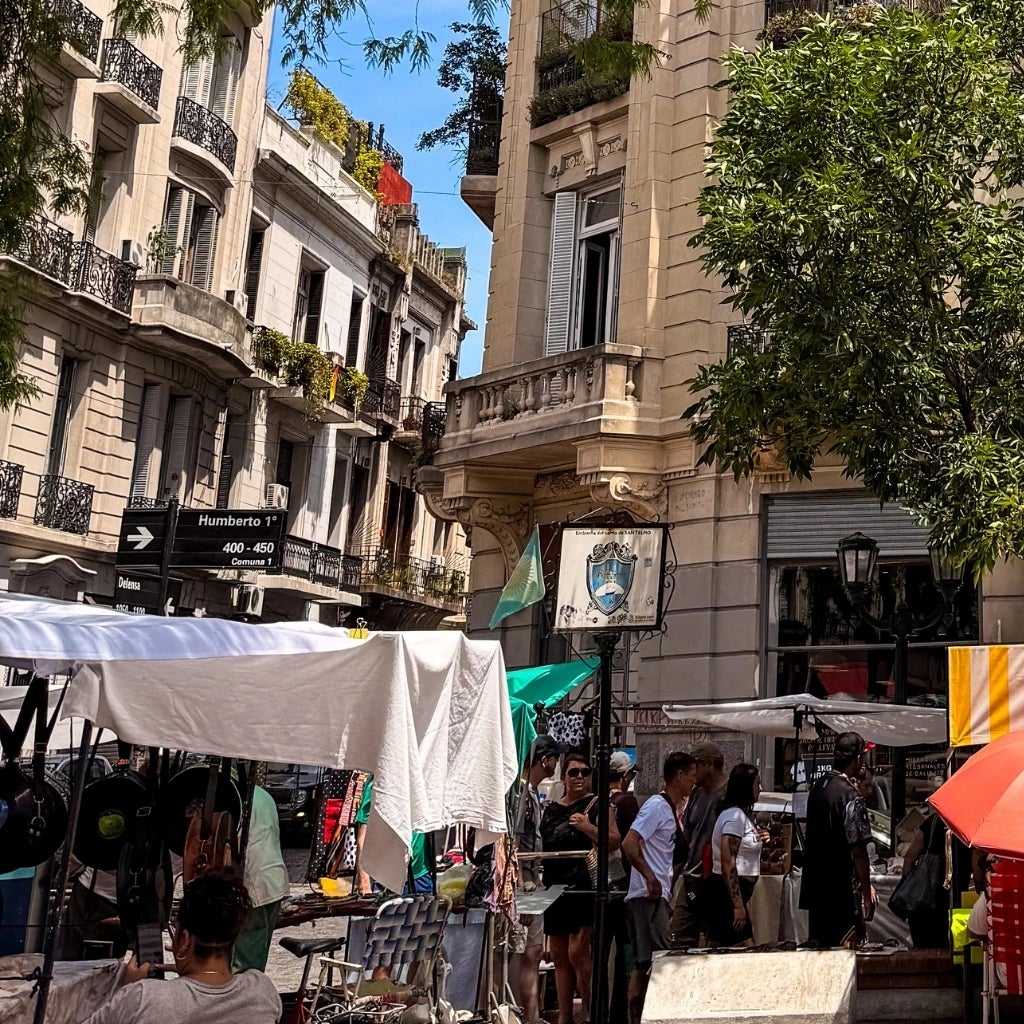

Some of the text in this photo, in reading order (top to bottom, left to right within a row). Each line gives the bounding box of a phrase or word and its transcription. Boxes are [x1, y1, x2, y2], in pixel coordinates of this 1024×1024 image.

[198, 514, 261, 527] Humberto
[222, 542, 245, 554] 400
[252, 542, 275, 554] 450
[231, 557, 272, 566] Comuna 1
[118, 576, 141, 591] Defensa
